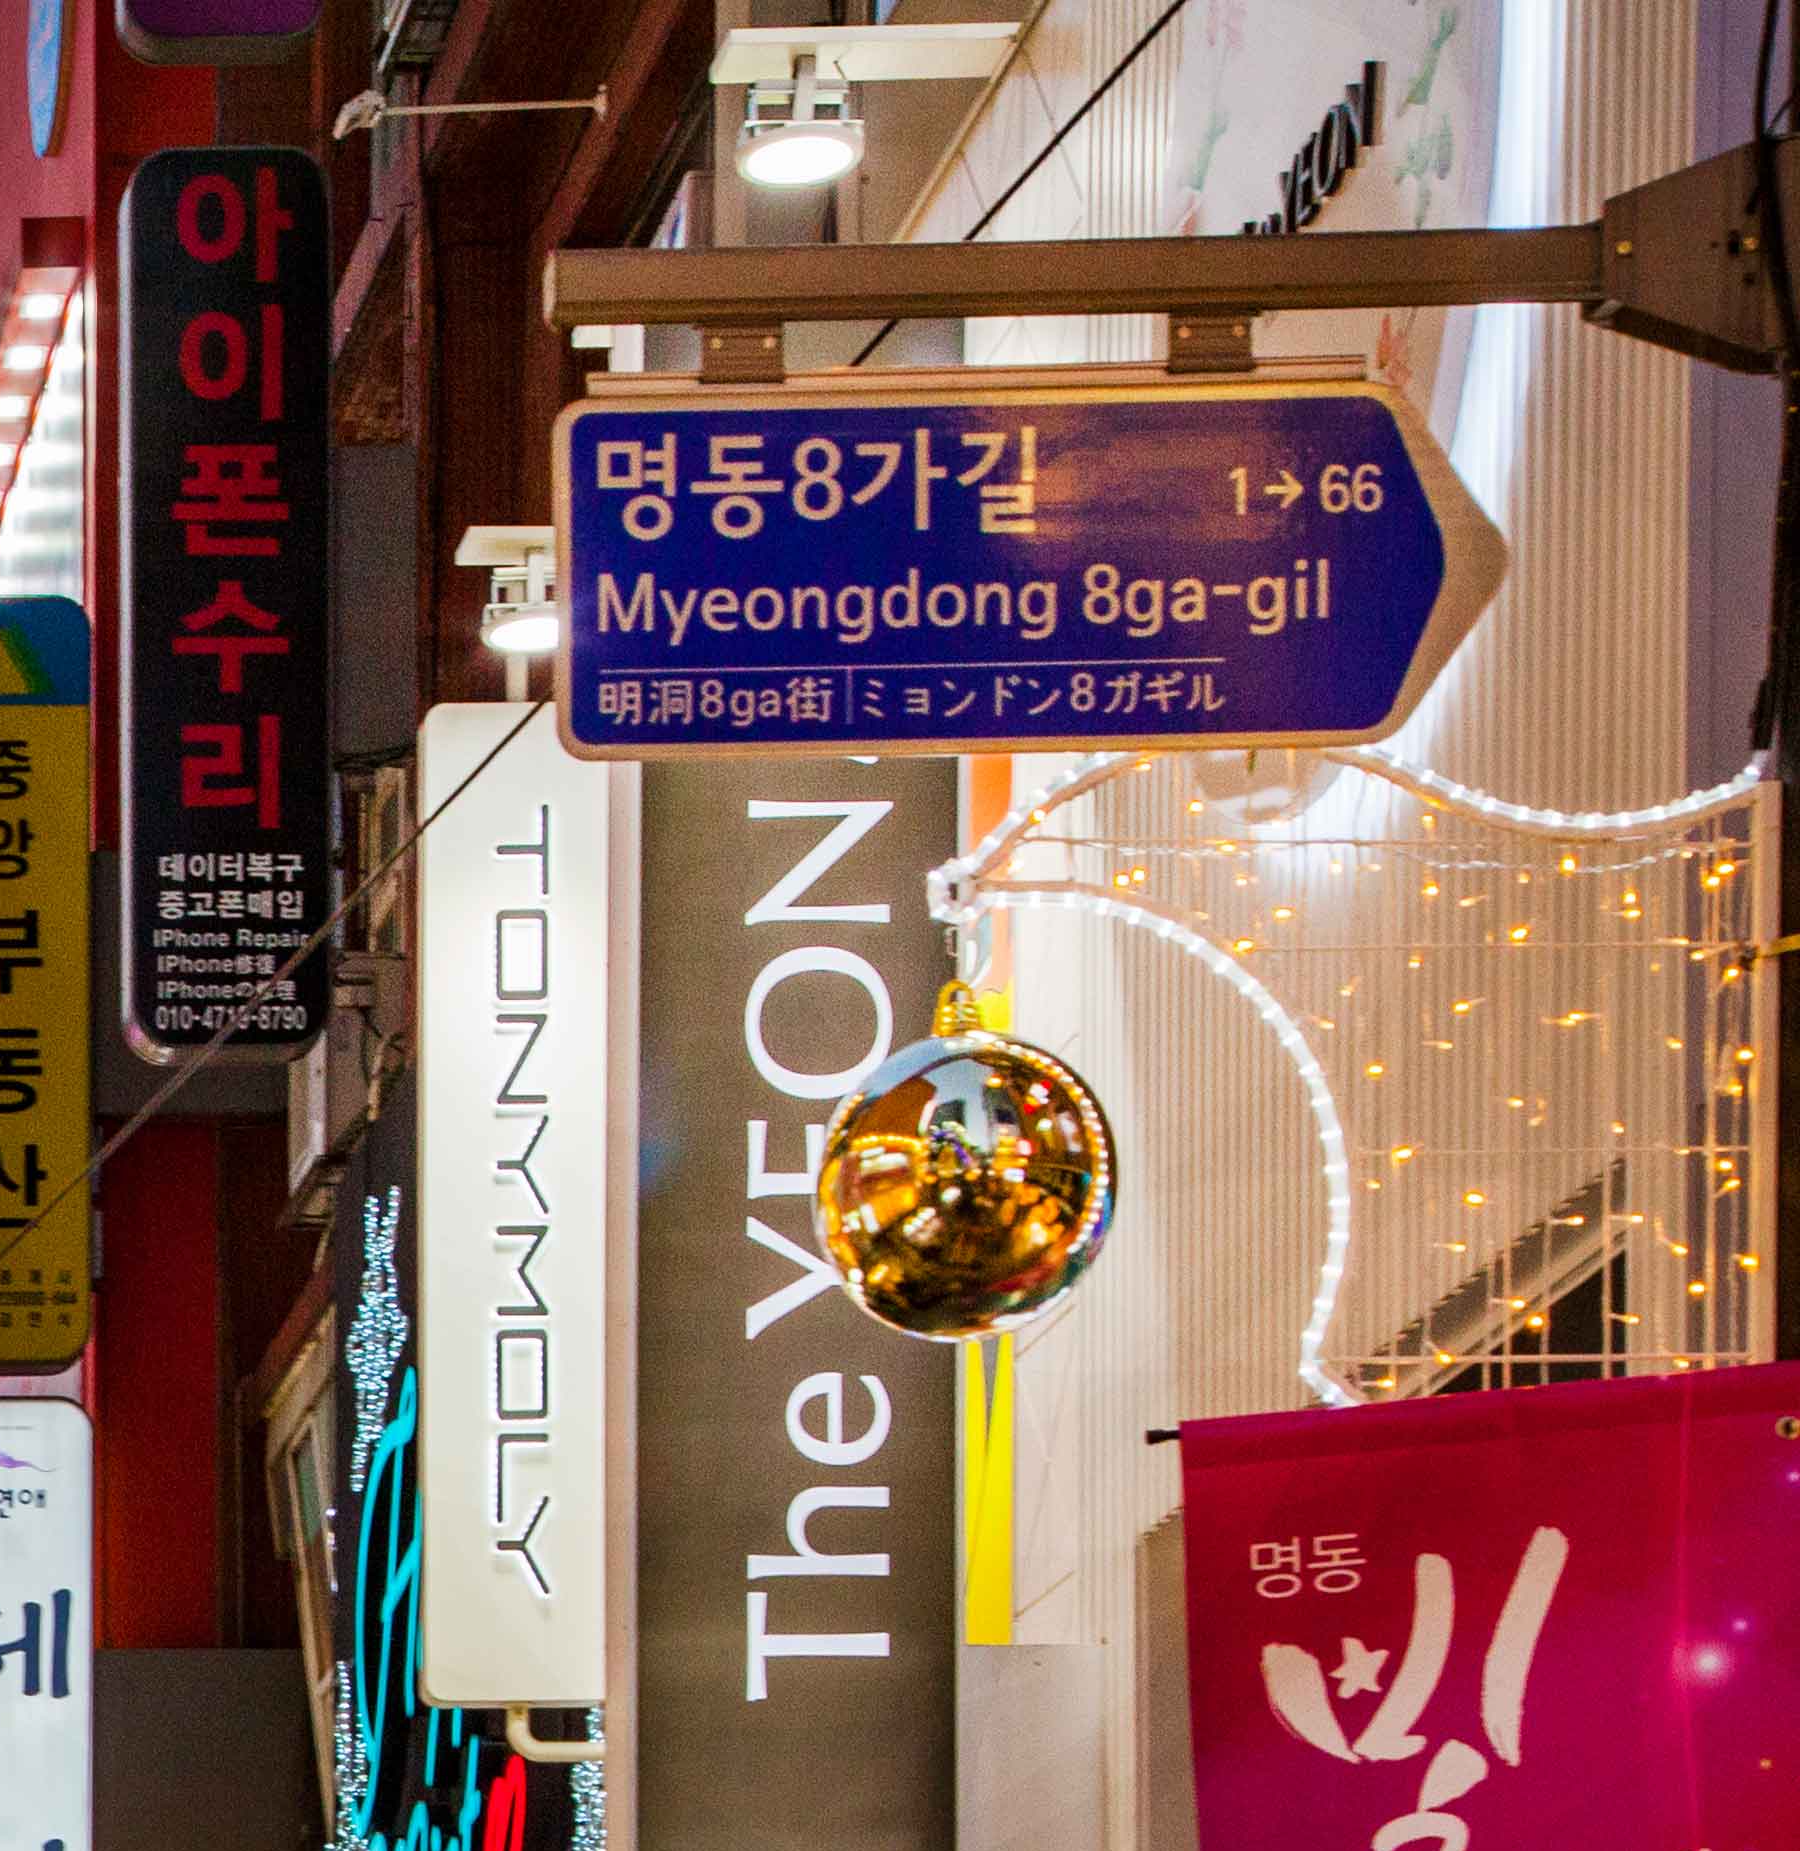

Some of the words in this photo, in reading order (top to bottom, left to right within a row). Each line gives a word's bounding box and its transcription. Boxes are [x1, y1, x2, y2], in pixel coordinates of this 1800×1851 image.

[171, 167, 294, 831] 아이폰수리
[597, 427, 1039, 541] 명동8가길
[1320, 464, 1384, 514] 66
[598, 564, 1058, 645] Myeongdong
[1082, 558, 1331, 638] 8ga-gil
[598, 677, 832, 725] 明洞8ga街
[861, 673, 1226, 716] ミョンドン8ガギル
[495, 803, 550, 1598] TONYMOLY
[745, 1371, 892, 1701] The
[1249, 1532, 1368, 1598] 명동
